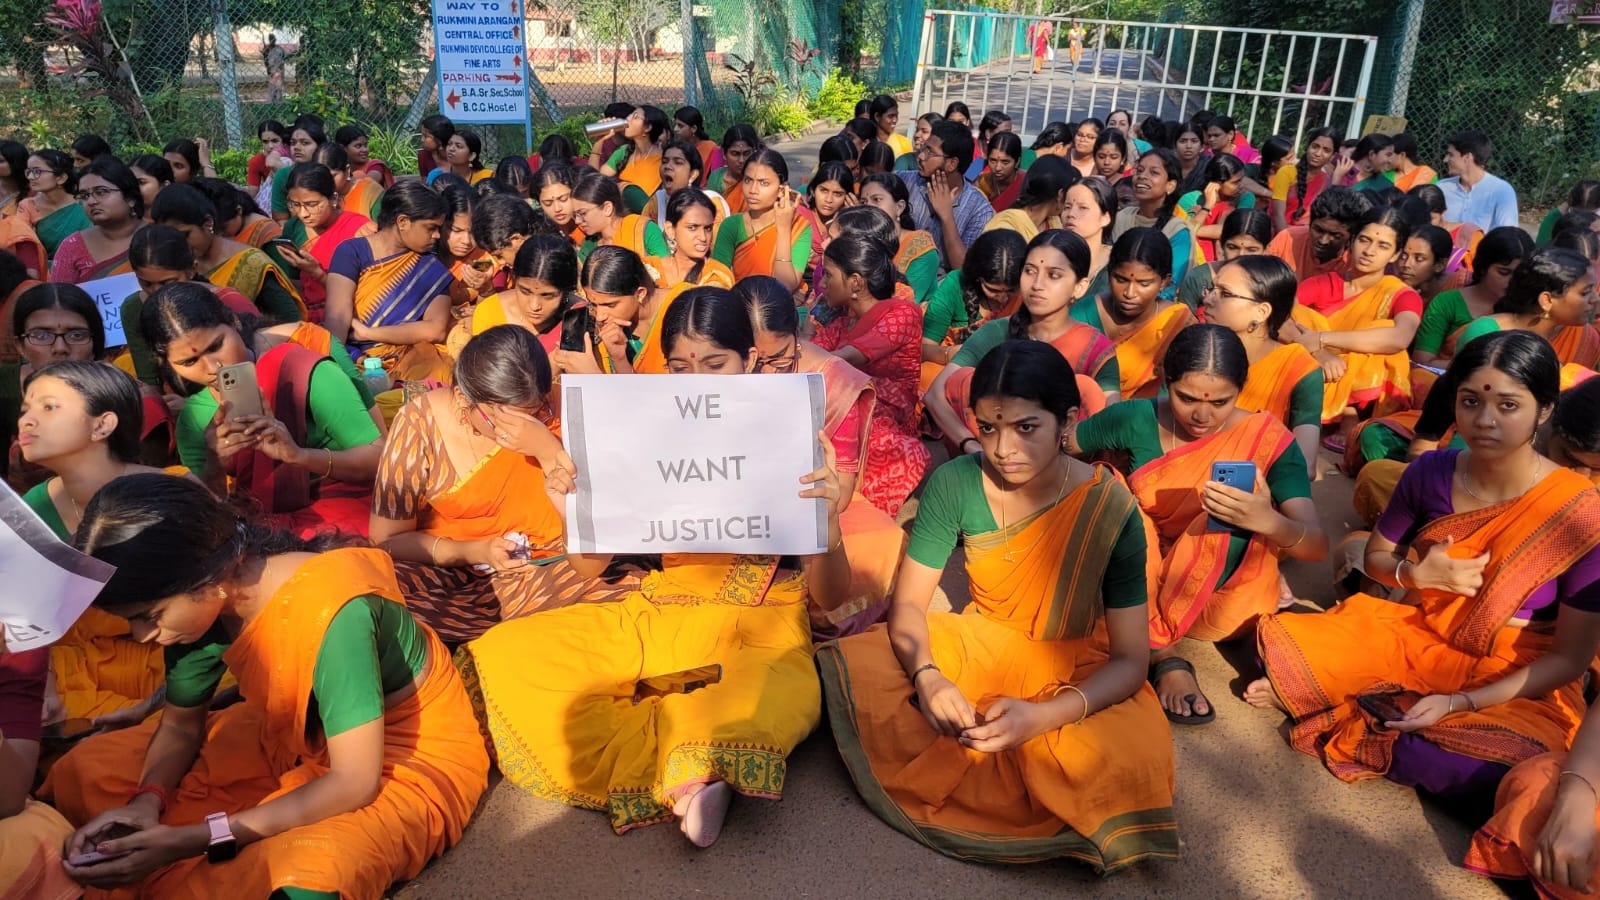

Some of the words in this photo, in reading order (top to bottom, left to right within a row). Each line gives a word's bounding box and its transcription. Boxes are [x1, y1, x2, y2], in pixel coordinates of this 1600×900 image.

[446, 3, 476, 11] WAY
[480, 3, 500, 11] TO
[437, 16, 477, 25] RUKMINI
[478, 16, 521, 25] ARANGAM
[444, 31, 484, 40] CENTRAL
[485, 31, 514, 40] OFFICE
[441, 45, 469, 54] RUKMINI
[470, 45, 484, 54] DEVI
[484, 45, 514, 54] COLLEGE
[515, 45, 523, 54] OF
[463, 59, 480, 69] FINE
[482, 59, 502, 69] ARTS
[442, 73, 491, 83] PARKING
[96, 292, 113, 306] E
[674, 394, 721, 420] WE
[656, 455, 746, 484] WANT
[641, 514, 770, 543] JUSTICE!
[7, 624, 51, 642] E!
